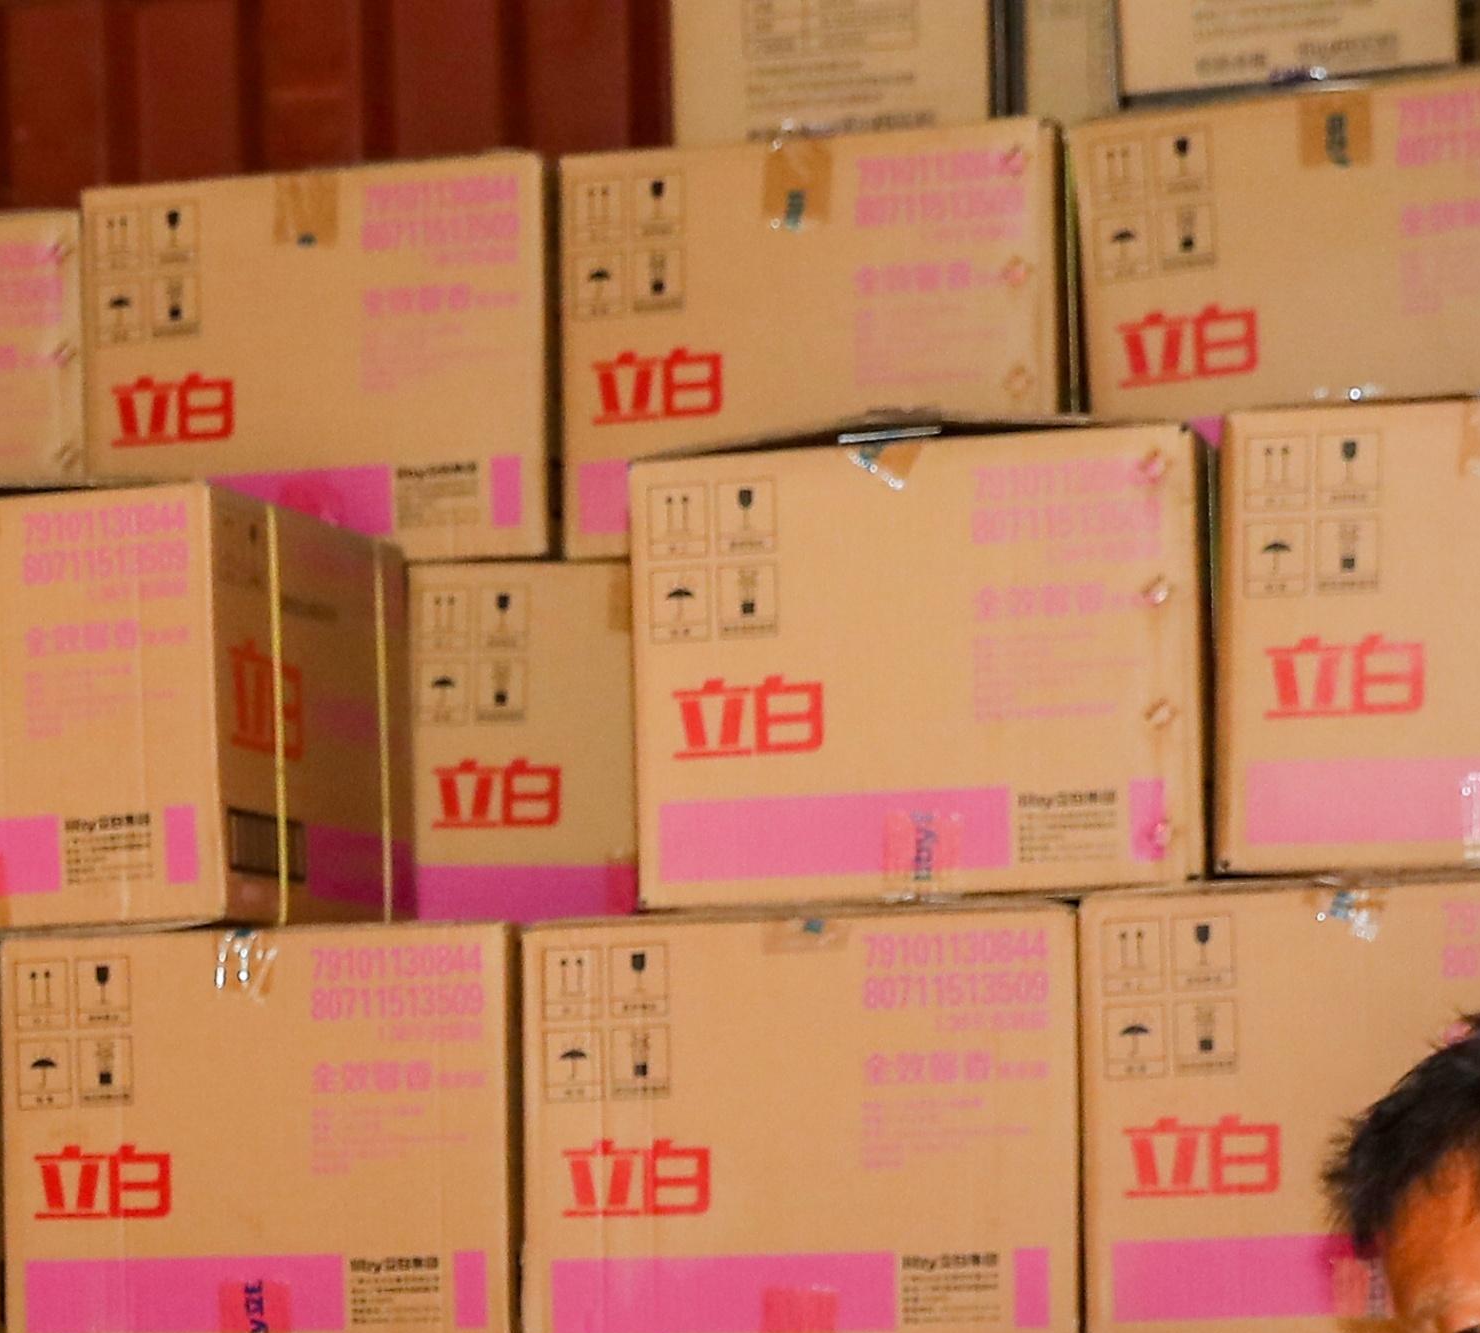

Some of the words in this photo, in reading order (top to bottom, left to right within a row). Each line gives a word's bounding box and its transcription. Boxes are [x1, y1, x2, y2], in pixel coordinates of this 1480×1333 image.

[1121, 305, 1258, 387] 立白
[114, 373, 234, 445] 立白
[596, 348, 722, 424] 立白
[1267, 634, 1424, 718] 立白
[675, 675, 824, 760] 立白
[435, 759, 561, 828] 立白
[36, 1144, 171, 1219] 立白
[565, 1139, 710, 1217] 立白
[1127, 1115, 1280, 1197] 立白
